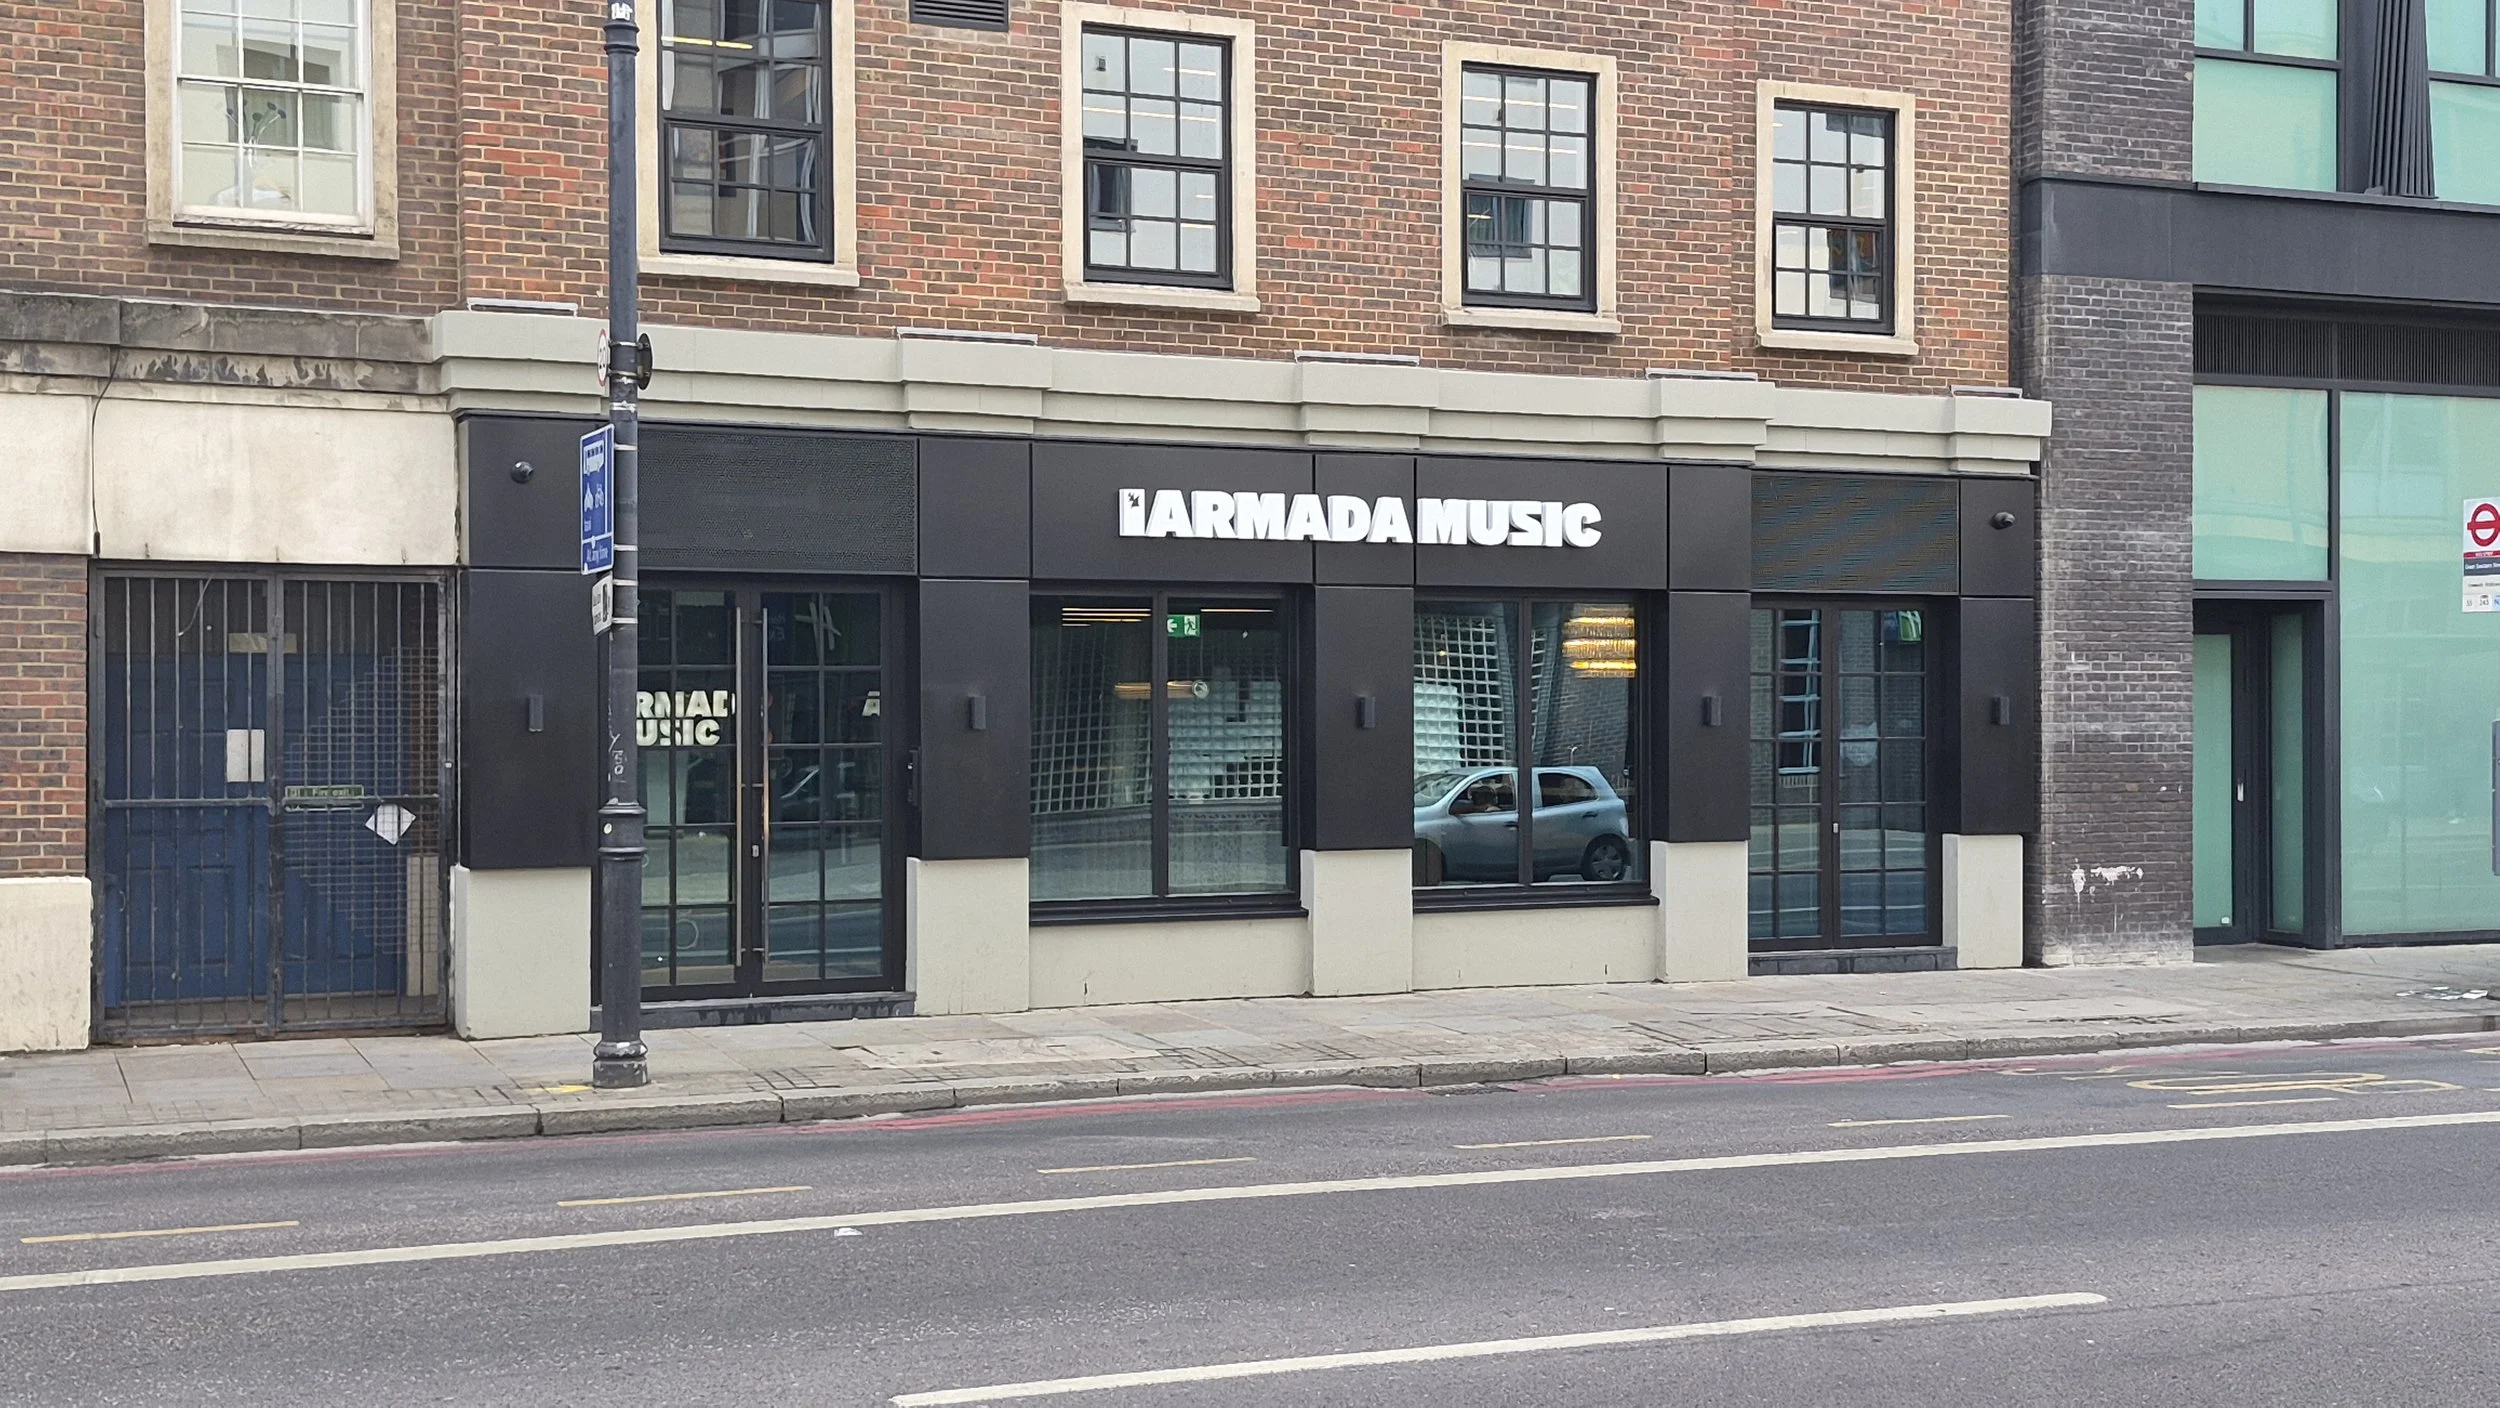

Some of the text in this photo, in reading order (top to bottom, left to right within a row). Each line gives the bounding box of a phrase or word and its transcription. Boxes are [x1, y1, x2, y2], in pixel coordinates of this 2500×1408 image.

[1145, 489, 1602, 547] ARMADA MUSIC
[636, 719, 721, 747] USIC
